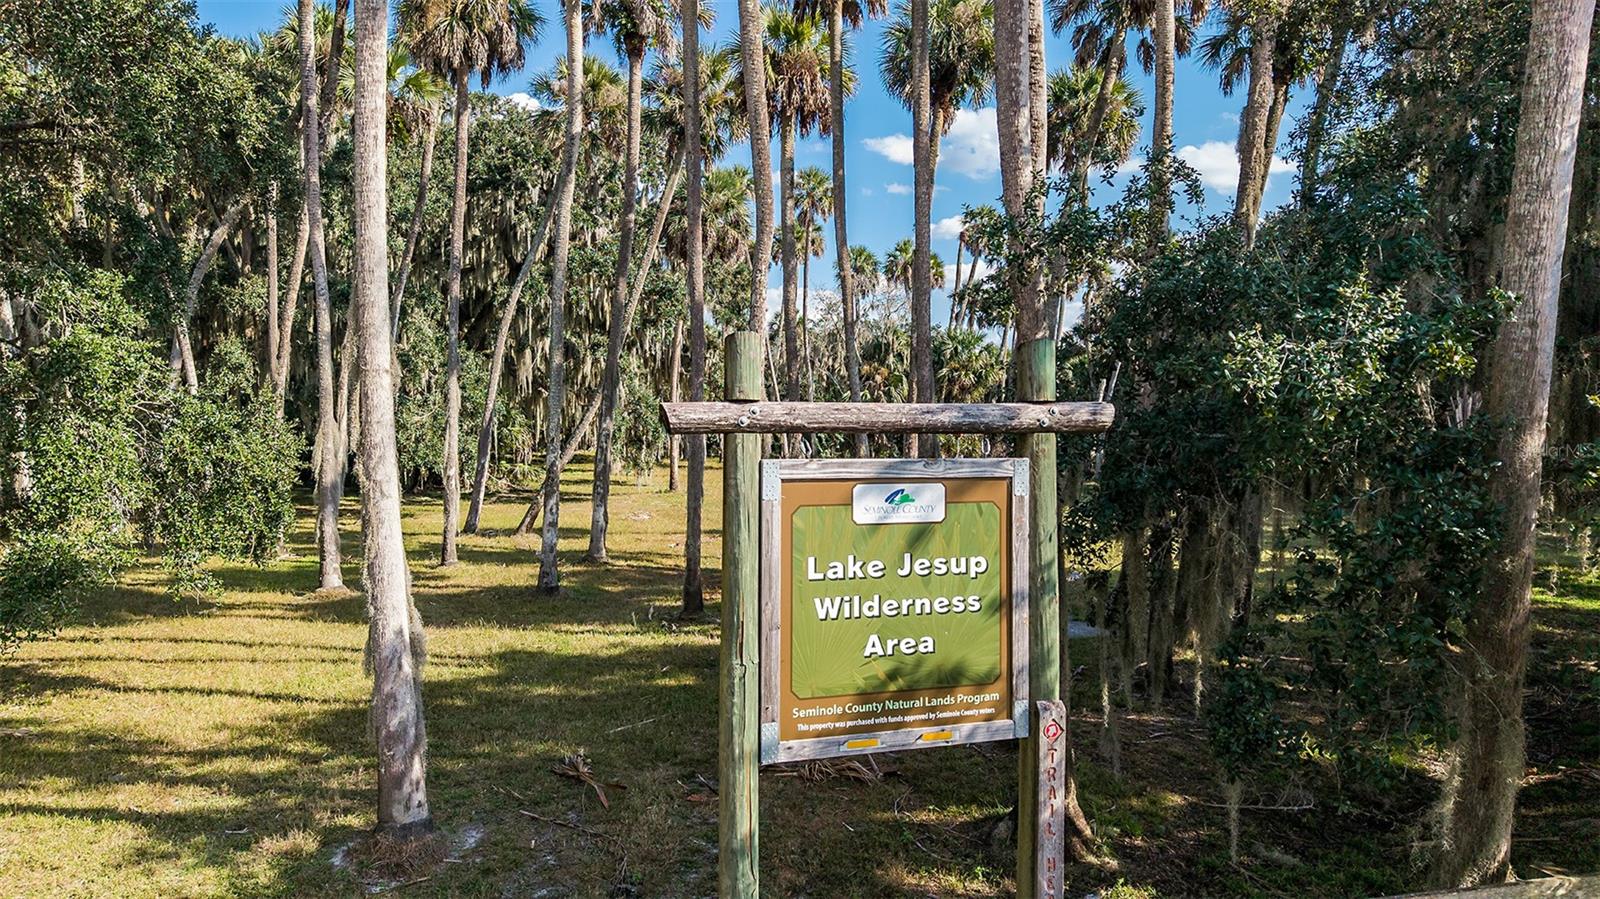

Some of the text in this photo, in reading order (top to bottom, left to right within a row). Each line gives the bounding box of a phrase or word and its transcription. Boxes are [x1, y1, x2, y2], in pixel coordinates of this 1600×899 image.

[807, 552, 989, 581] Lake Jesup
[814, 594, 982, 621] Wilderness
[863, 633, 936, 658] Area
[792, 692, 1000, 718] Seminole County Natural Lands Program
[797, 723, 809, 731] This
[810, 721, 834, 731] property
[846, 717, 874, 729] purchased
[904, 712, 929, 722] approved
[929, 712, 936, 720] by
[936, 709, 961, 718] Seminole
[961, 708, 981, 717] County
[980, 707, 996, 715] voters
[1045, 748, 1058, 899] TRAIL HE
